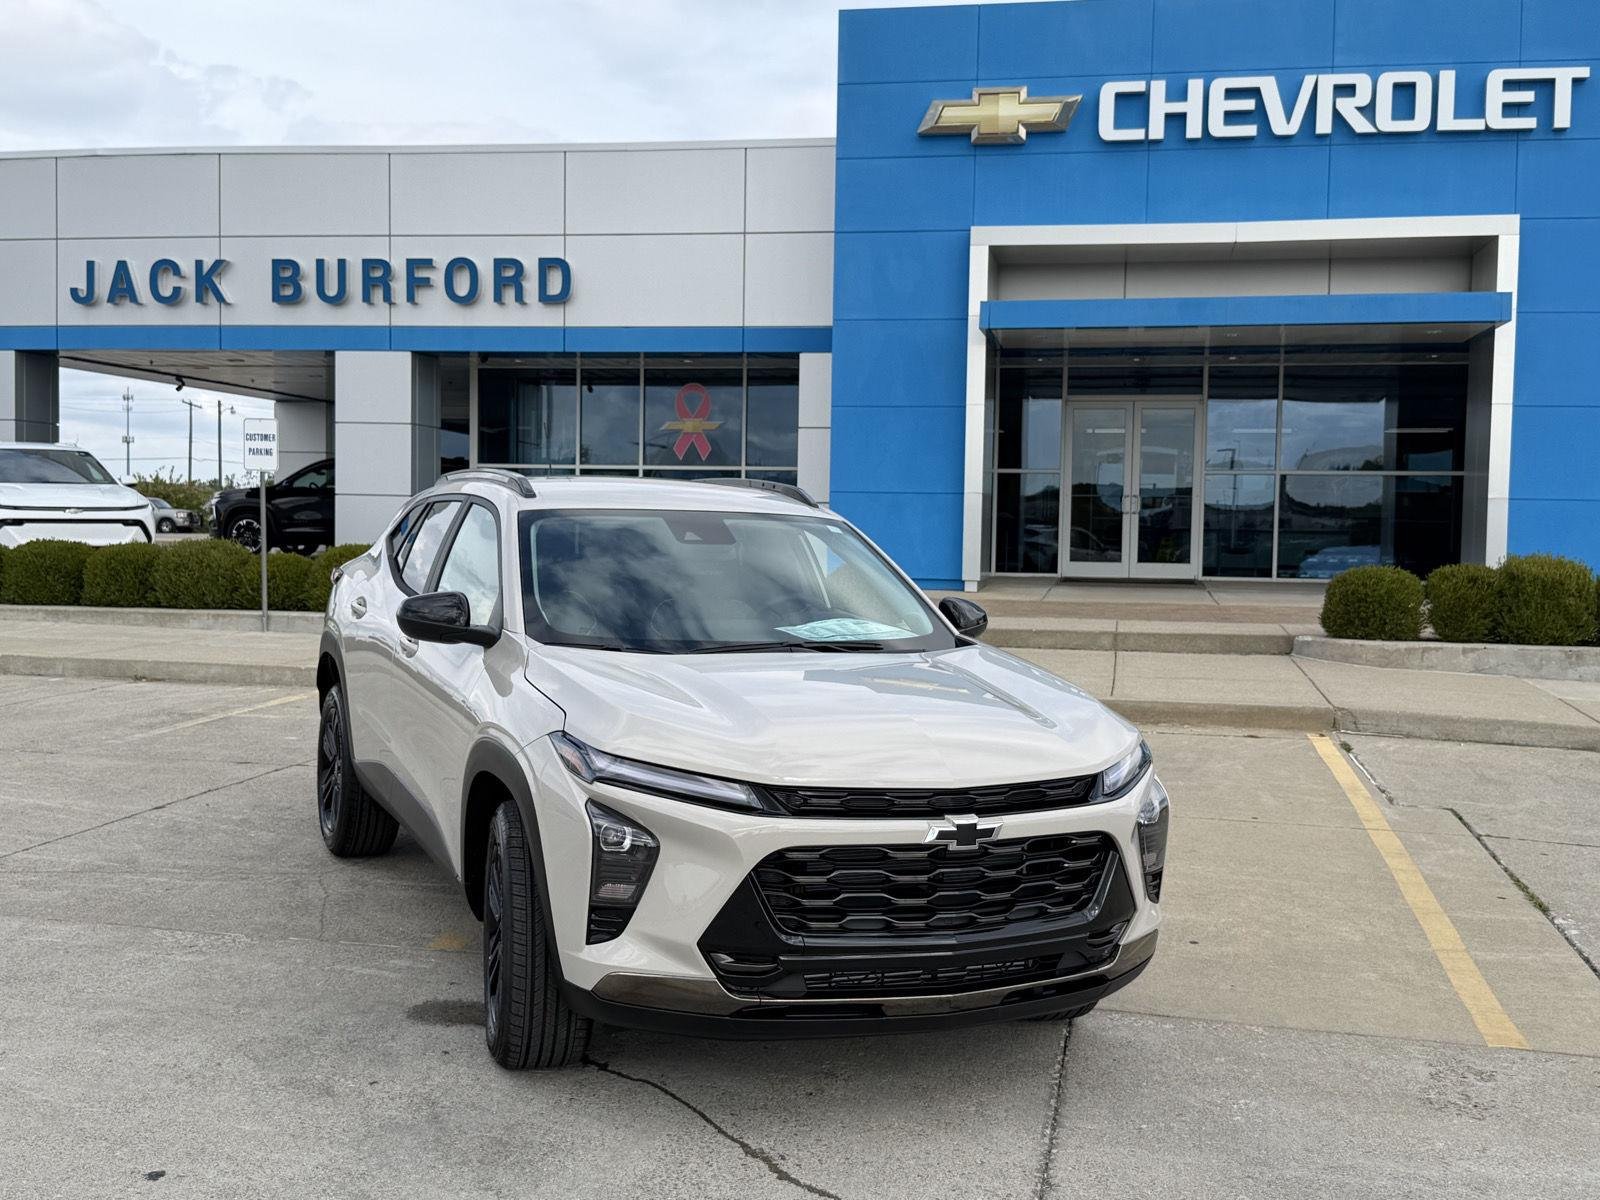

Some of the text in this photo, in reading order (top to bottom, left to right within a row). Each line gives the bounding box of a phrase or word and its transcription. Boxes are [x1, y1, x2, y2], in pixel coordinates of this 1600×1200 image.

[1097, 66, 1591, 141] CHEVROLET
[70, 257, 573, 305] JACK BURFORD
[245, 433, 276, 442] CUSTOMER
[248, 447, 273, 456] PARKING
